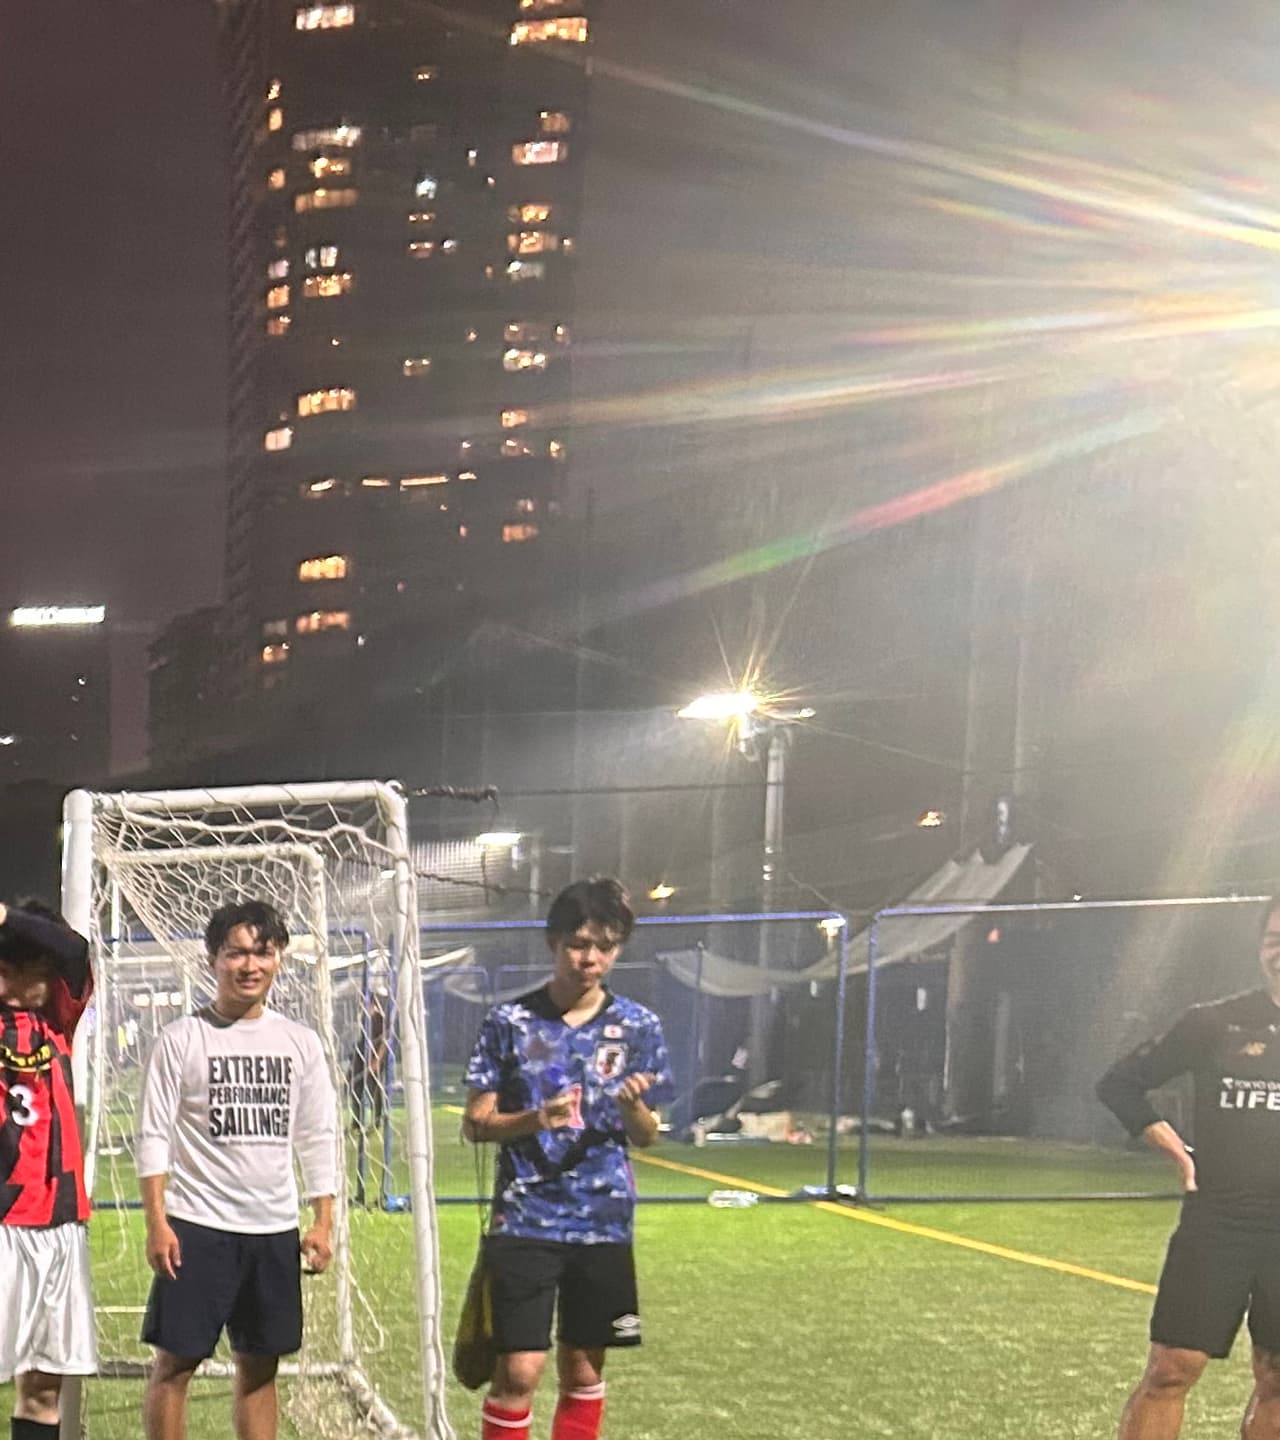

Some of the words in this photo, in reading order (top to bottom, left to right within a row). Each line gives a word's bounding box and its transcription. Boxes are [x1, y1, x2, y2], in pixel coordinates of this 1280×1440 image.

[208, 1056, 292, 1084] EXTREME
[9, 1084, 39, 1126] 3
[208, 1106, 281, 1137] SAILING
